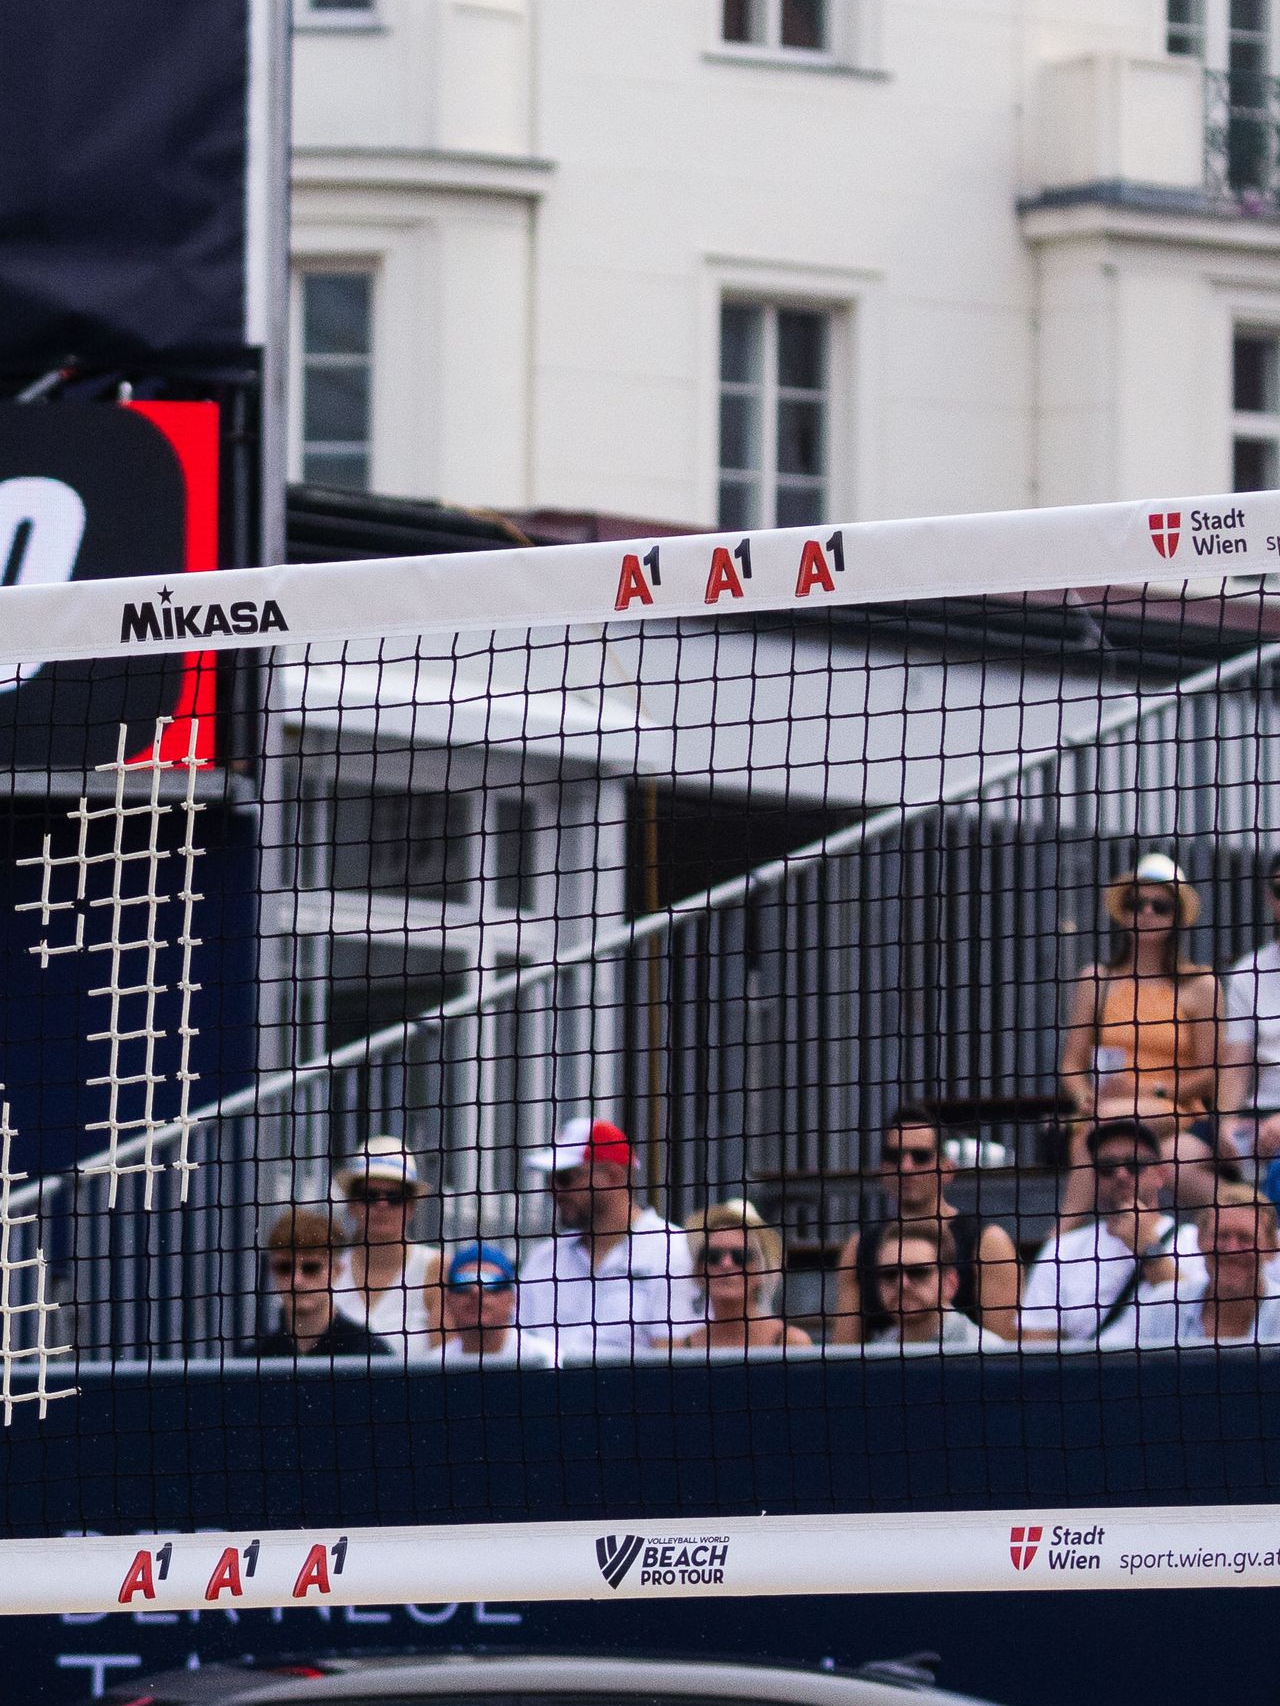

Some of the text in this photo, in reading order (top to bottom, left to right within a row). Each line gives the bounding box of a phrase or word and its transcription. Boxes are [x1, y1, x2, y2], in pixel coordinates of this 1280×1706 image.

[1190, 509, 1246, 533] Stadt
[1192, 535, 1248, 557] Wien
[705, 538, 753, 604] A1
[795, 530, 846, 598] A1
[614, 546, 662, 612] A1
[647, 1536, 730, 1545] VOLLEYBALL WORLD
[1050, 1525, 1106, 1546] Stadt
[292, 1536, 349, 1599] A1
[642, 1545, 729, 1568] BEACH
[1048, 1549, 1101, 1570] Wien
[118, 1542, 174, 1604] A1
[205, 1539, 260, 1601] A1
[641, 1569, 724, 1586] PRO TOUR
